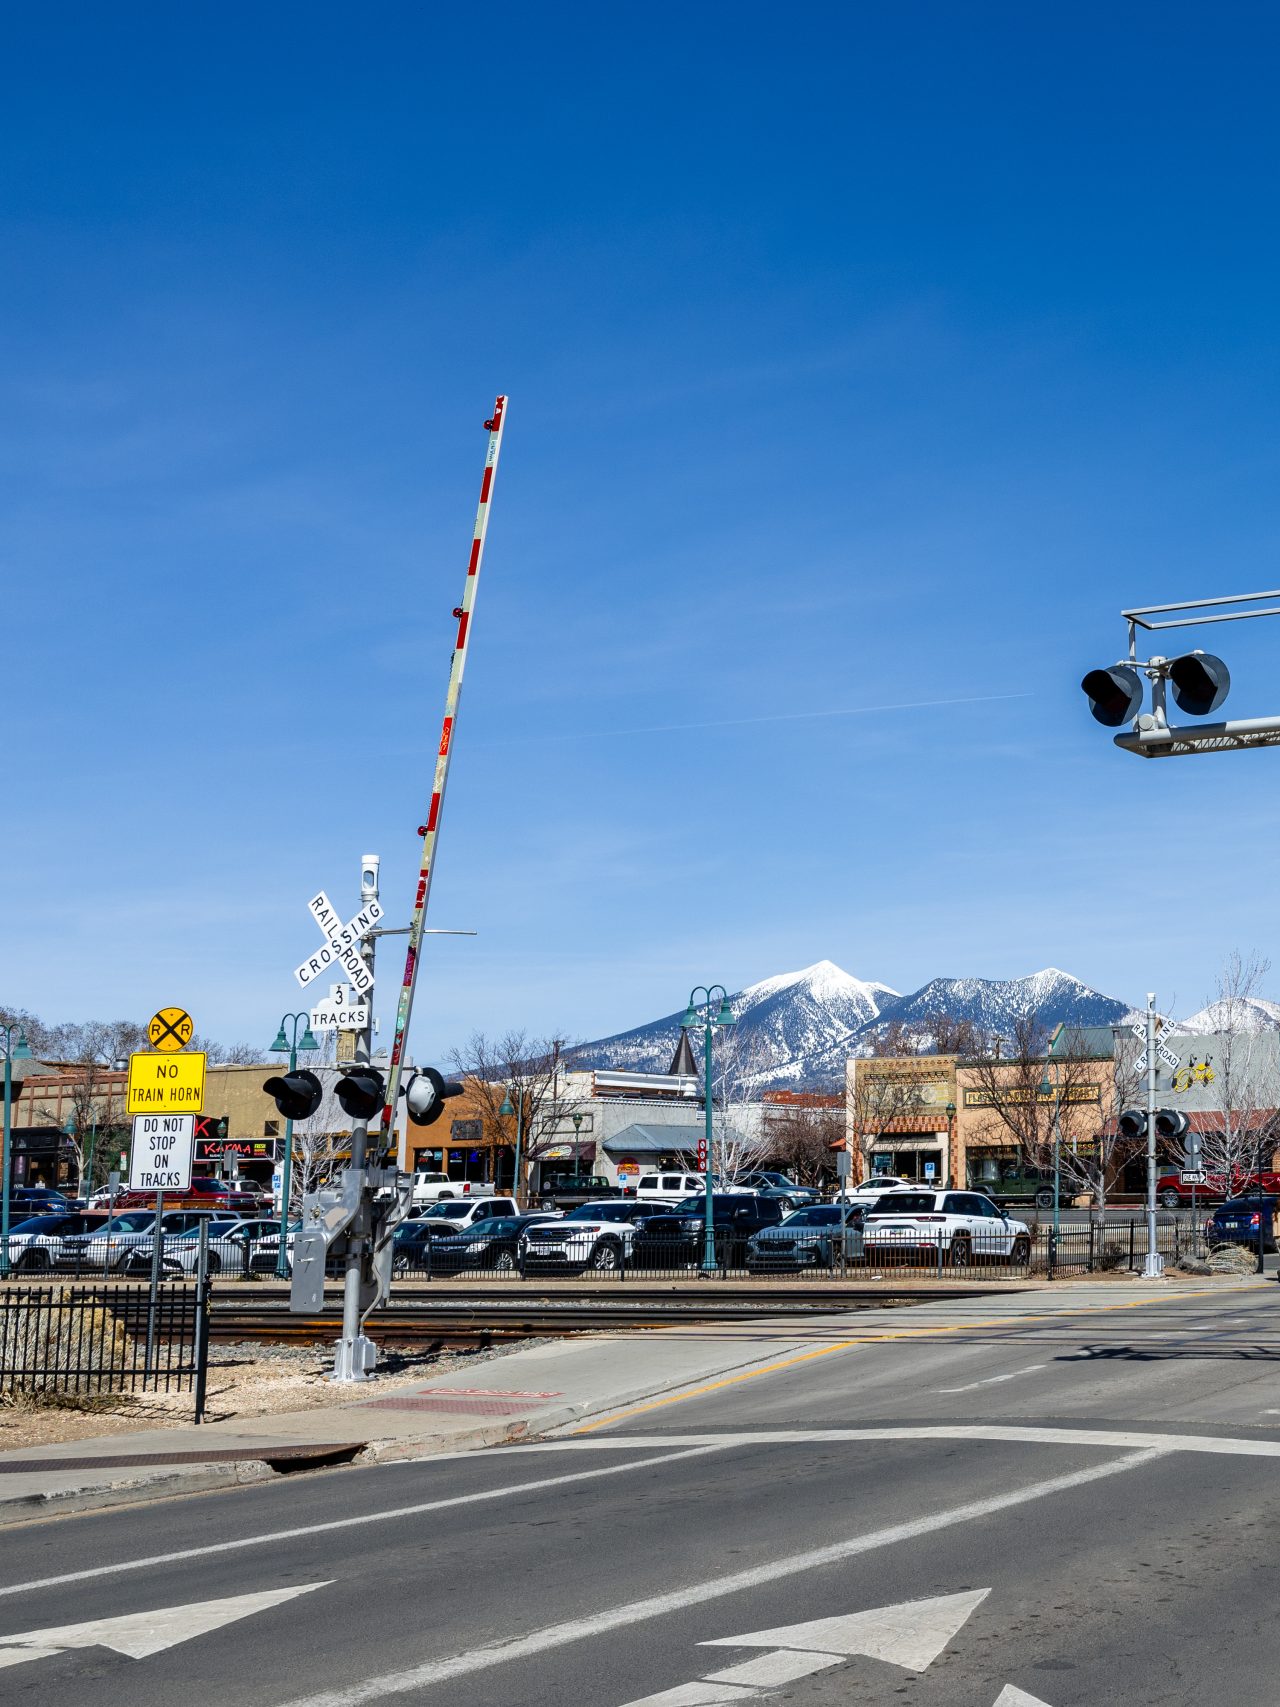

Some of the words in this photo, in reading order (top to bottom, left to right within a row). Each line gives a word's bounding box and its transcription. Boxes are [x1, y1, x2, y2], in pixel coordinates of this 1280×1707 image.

[299, 904, 380, 982] CROSSING
[311, 896, 339, 939] RAIL
[340, 947, 369, 989] ROAD
[335, 990, 343, 1005] 3
[312, 1011, 365, 1025] TRACKS
[152, 1025, 161, 1035] R
[180, 1024, 190, 1035] R
[1155, 1045, 1178, 1067] ROAD
[156, 1065, 178, 1079] NO
[132, 1088, 164, 1102] TRAIN
[170, 1087, 201, 1101] HORN
[144, 1118, 159, 1132] DO
[163, 1118, 184, 1132] NOT
[149, 1136, 176, 1151] STOP
[154, 1154, 169, 1169] ON
[140, 1171, 181, 1188] TRACKS
